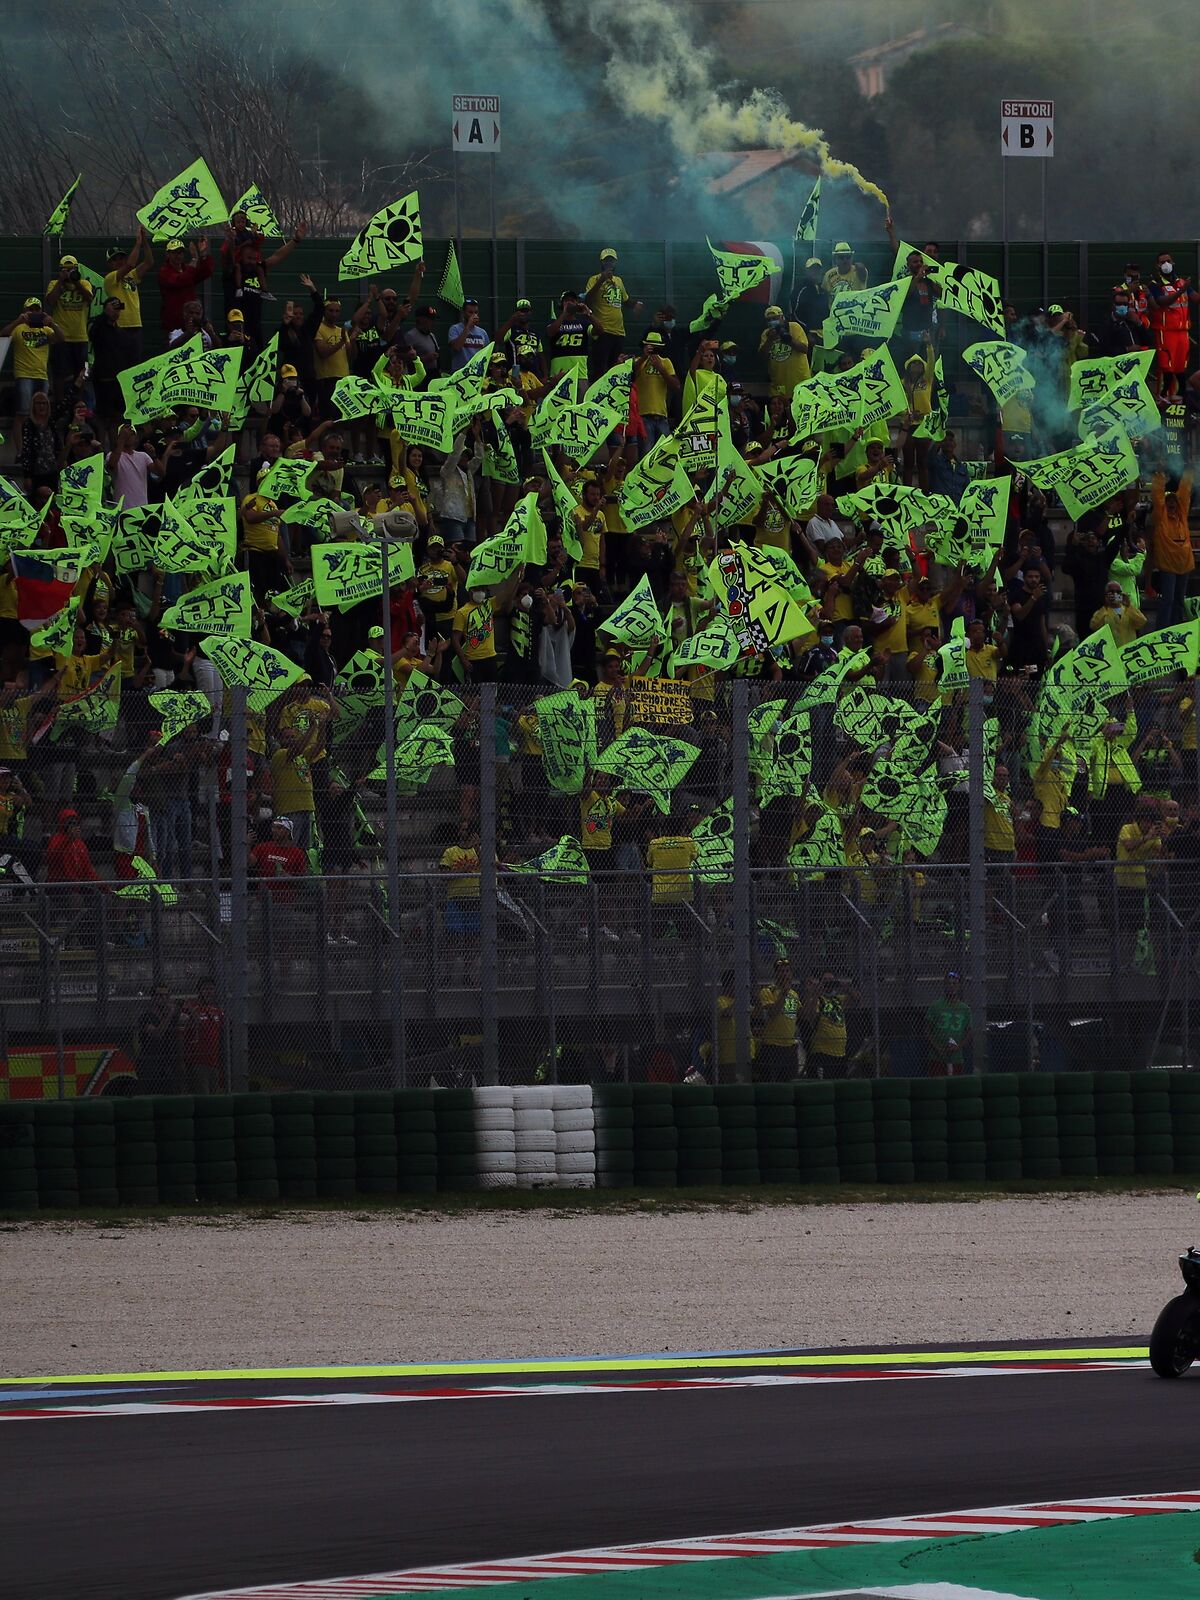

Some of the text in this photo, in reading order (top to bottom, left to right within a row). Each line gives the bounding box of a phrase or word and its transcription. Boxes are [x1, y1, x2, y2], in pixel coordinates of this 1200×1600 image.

[454, 97, 497, 111] SETTORI
[1004, 103, 1051, 116] SETTORI
[468, 118, 483, 144] A
[1020, 124, 1035, 149] B
[514, 333, 538, 347] 46
[554, 333, 583, 347] 46
[391, 399, 447, 423] 46
[1166, 404, 1187, 416] 46
[397, 423, 431, 437] TWENTY-FIFTH
[1166, 418, 1185, 428] THANK
[1167, 431, 1178, 442] YOU
[1167, 444, 1181, 455] VALE
